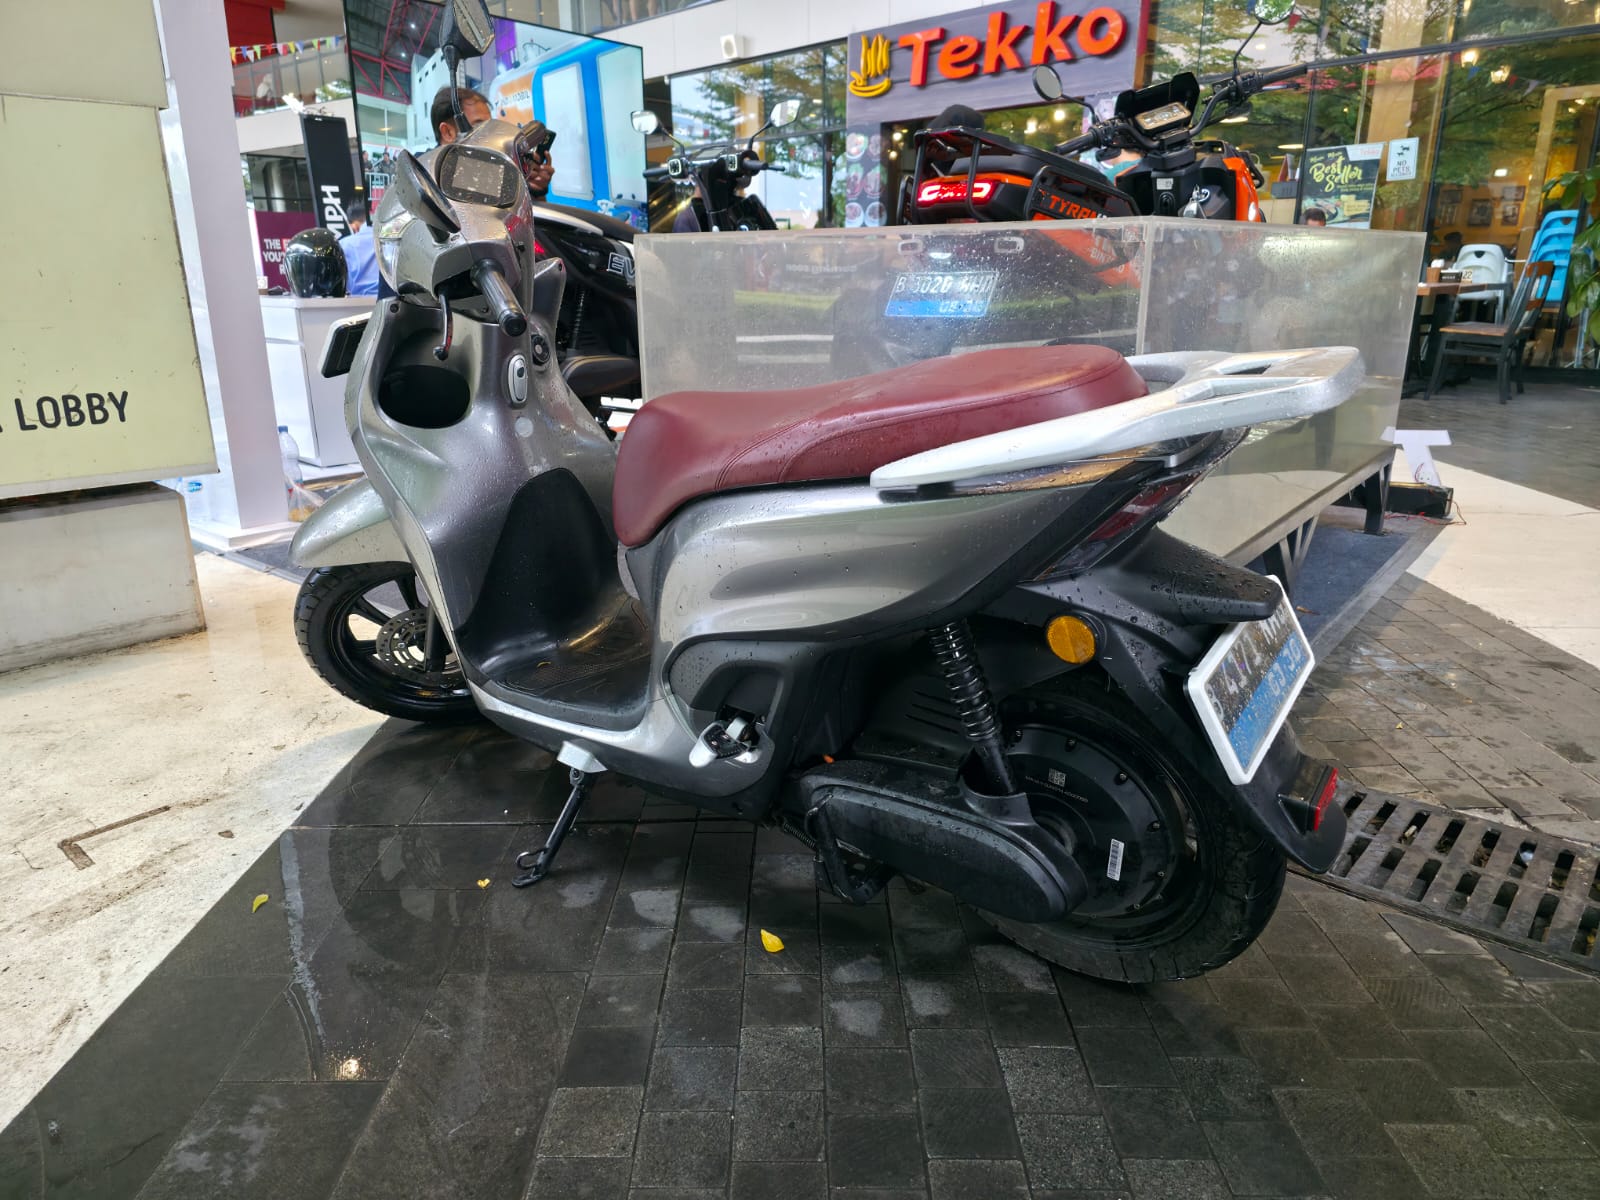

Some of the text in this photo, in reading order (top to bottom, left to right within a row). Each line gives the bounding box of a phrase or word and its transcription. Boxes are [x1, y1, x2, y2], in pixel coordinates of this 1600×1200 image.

[898, 1, 1127, 87] Tekko
[1309, 155, 1345, 183] Best
[1324, 164, 1363, 193] Seller
[263, 238, 282, 250] THE
[14, 390, 128, 431] LOBBY
